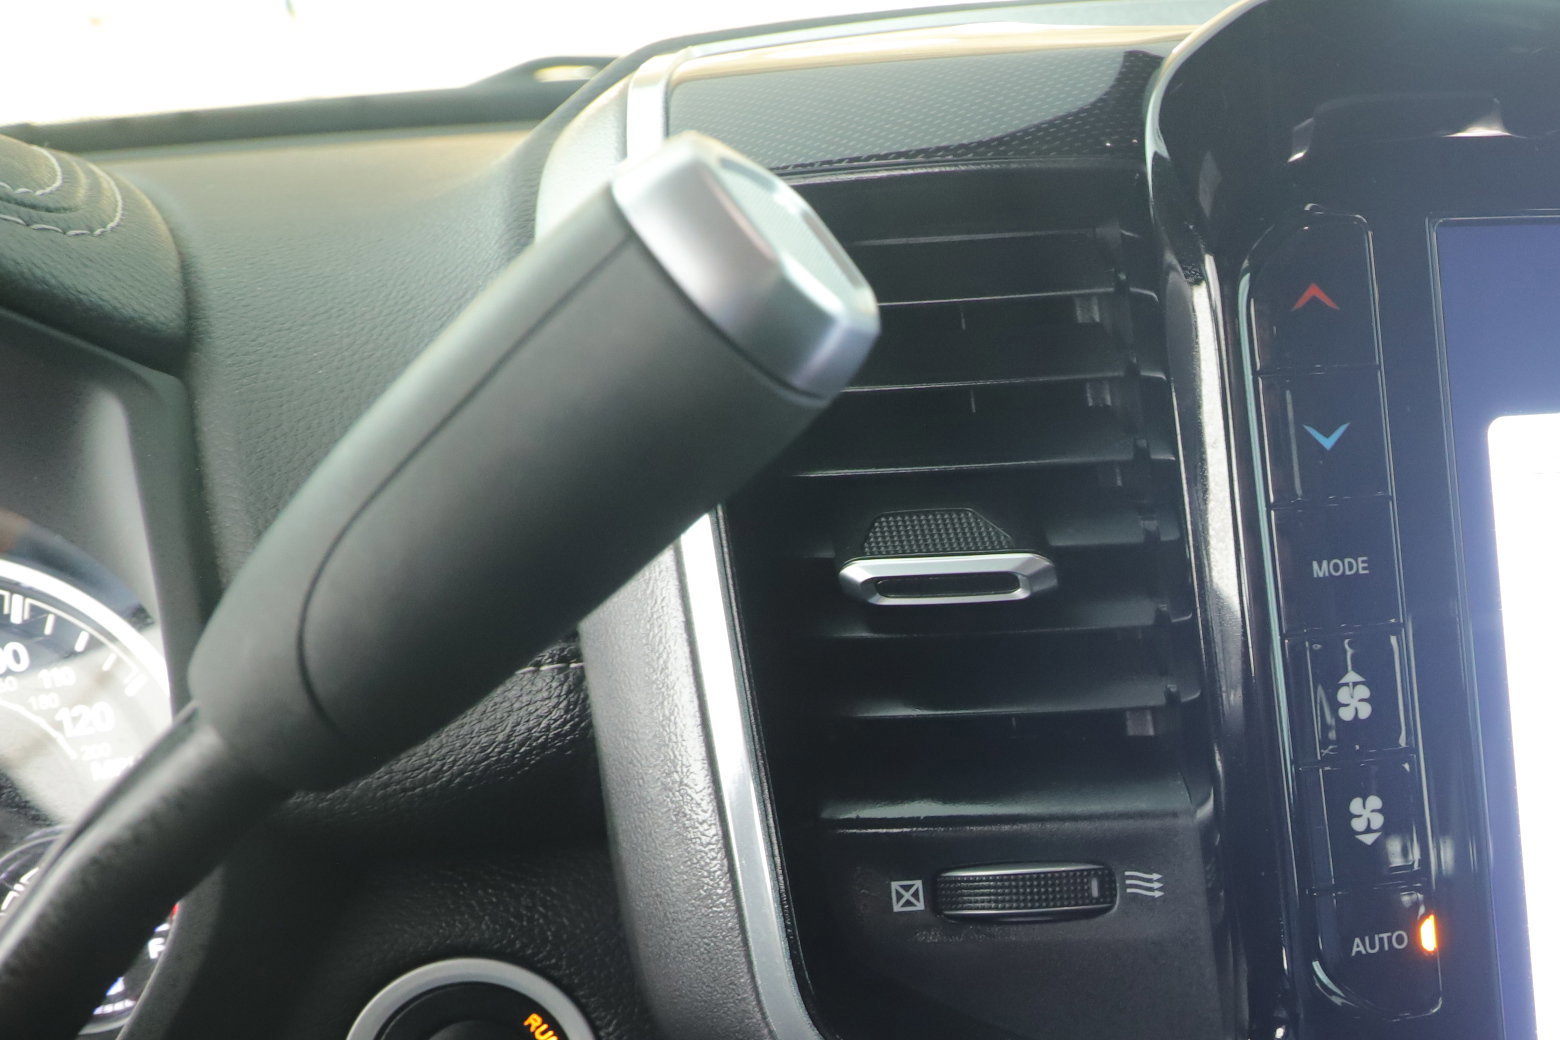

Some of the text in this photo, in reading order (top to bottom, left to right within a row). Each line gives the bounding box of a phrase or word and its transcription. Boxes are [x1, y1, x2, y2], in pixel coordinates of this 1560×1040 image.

[1312, 557, 1370, 578] MODE
[55, 701, 115, 738] 120
[1351, 930, 1408, 957] AUTO
